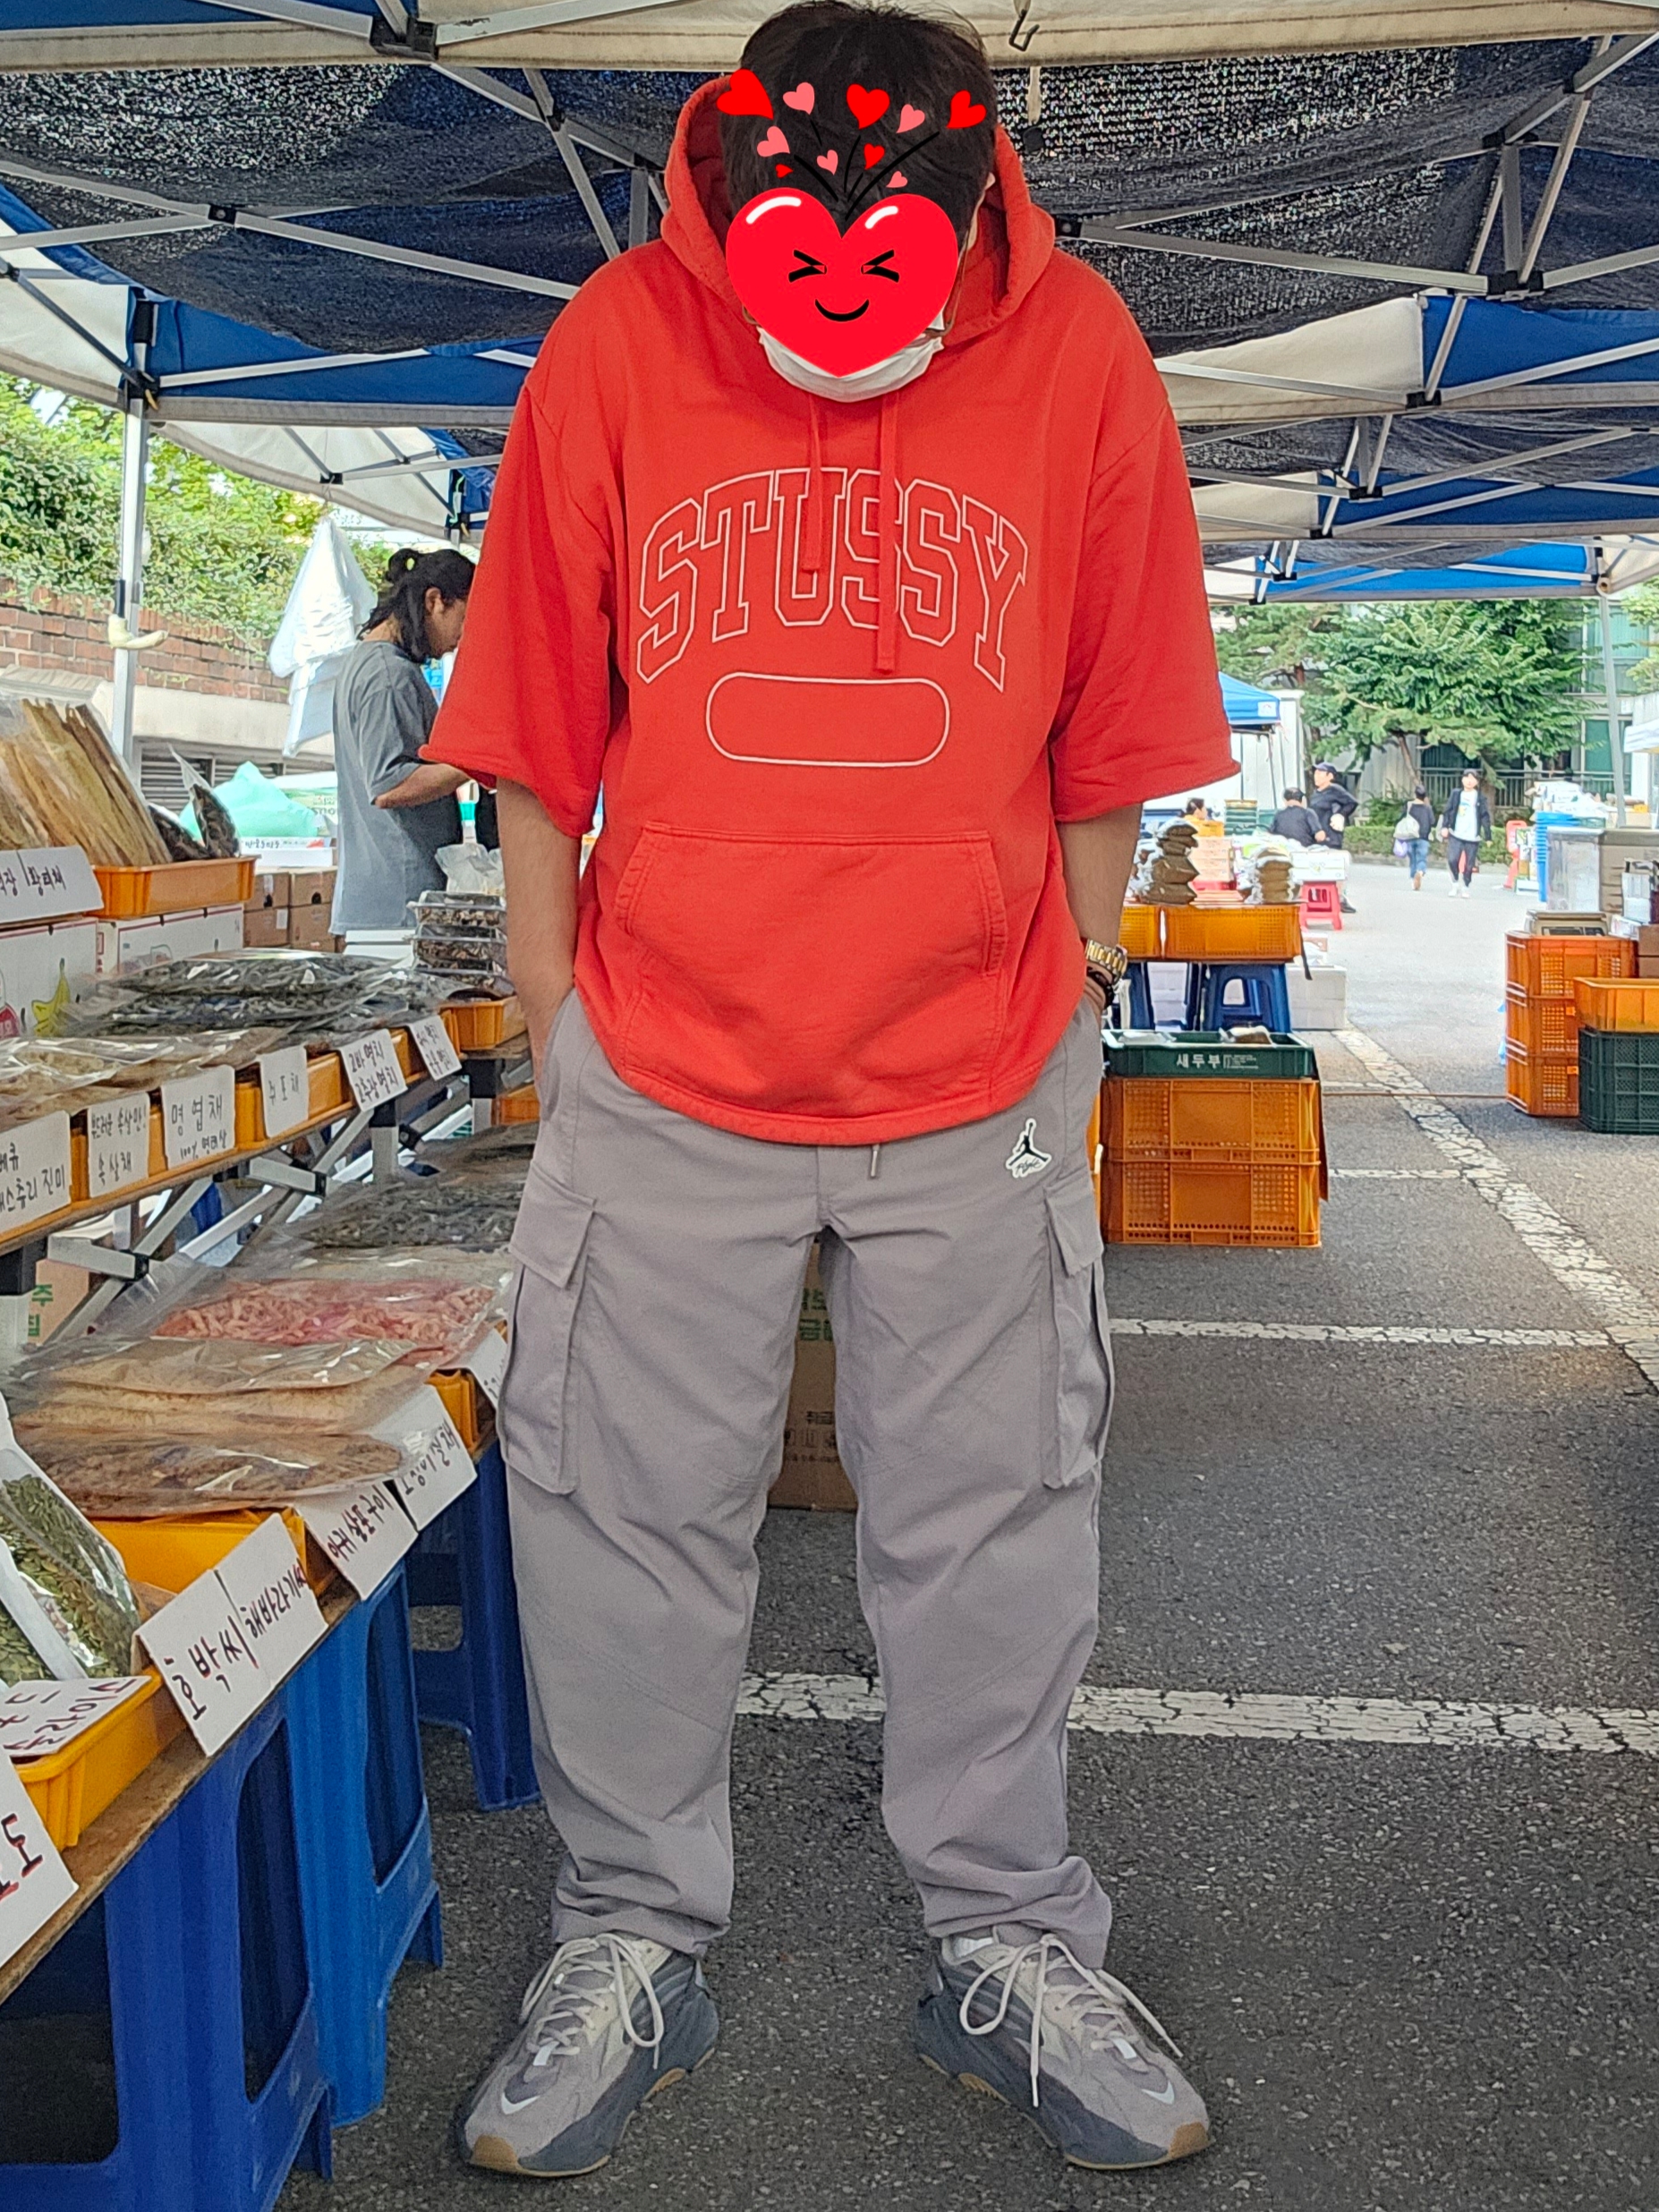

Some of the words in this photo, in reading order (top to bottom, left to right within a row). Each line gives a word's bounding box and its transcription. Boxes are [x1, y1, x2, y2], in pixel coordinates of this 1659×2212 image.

[636, 466, 1028, 693] STUSSY
[1176, 1053, 1221, 1069] 새두부
[41, 1164, 65, 1195] 진미
